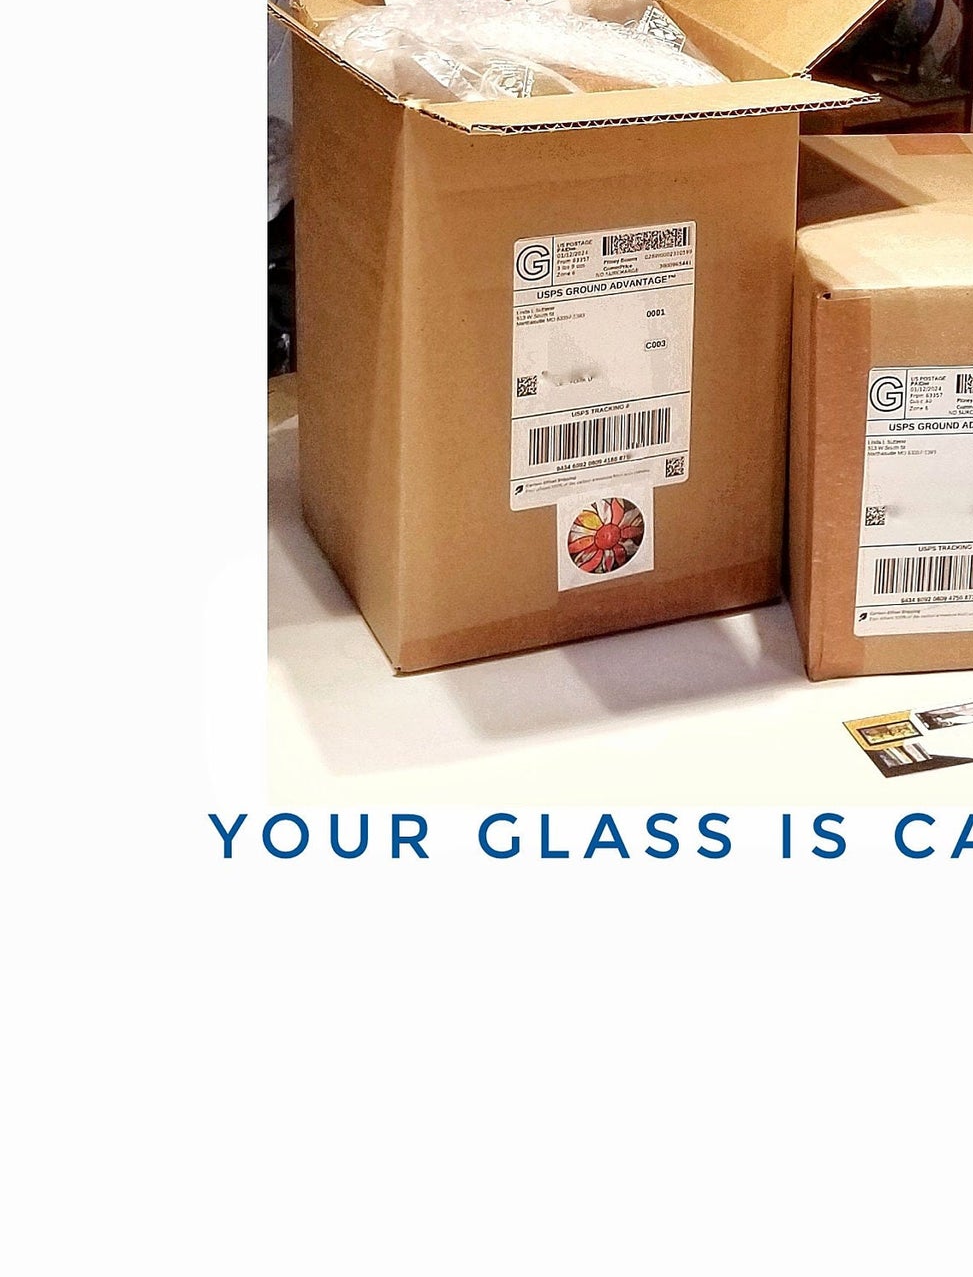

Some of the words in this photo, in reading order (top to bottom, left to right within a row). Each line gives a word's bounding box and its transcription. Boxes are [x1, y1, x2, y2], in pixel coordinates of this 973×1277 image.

[516, 244, 550, 281] G
[537, 286, 563, 300] USPS
[566, 283, 607, 296] GROUND
[646, 309, 666, 318] 0001
[645, 339, 666, 350] C003
[869, 375, 904, 412] G
[571, 409, 590, 418] USPS
[591, 405, 625, 415] TRACKING
[889, 423, 915, 431] USPS
[917, 422, 960, 431] GROUND
